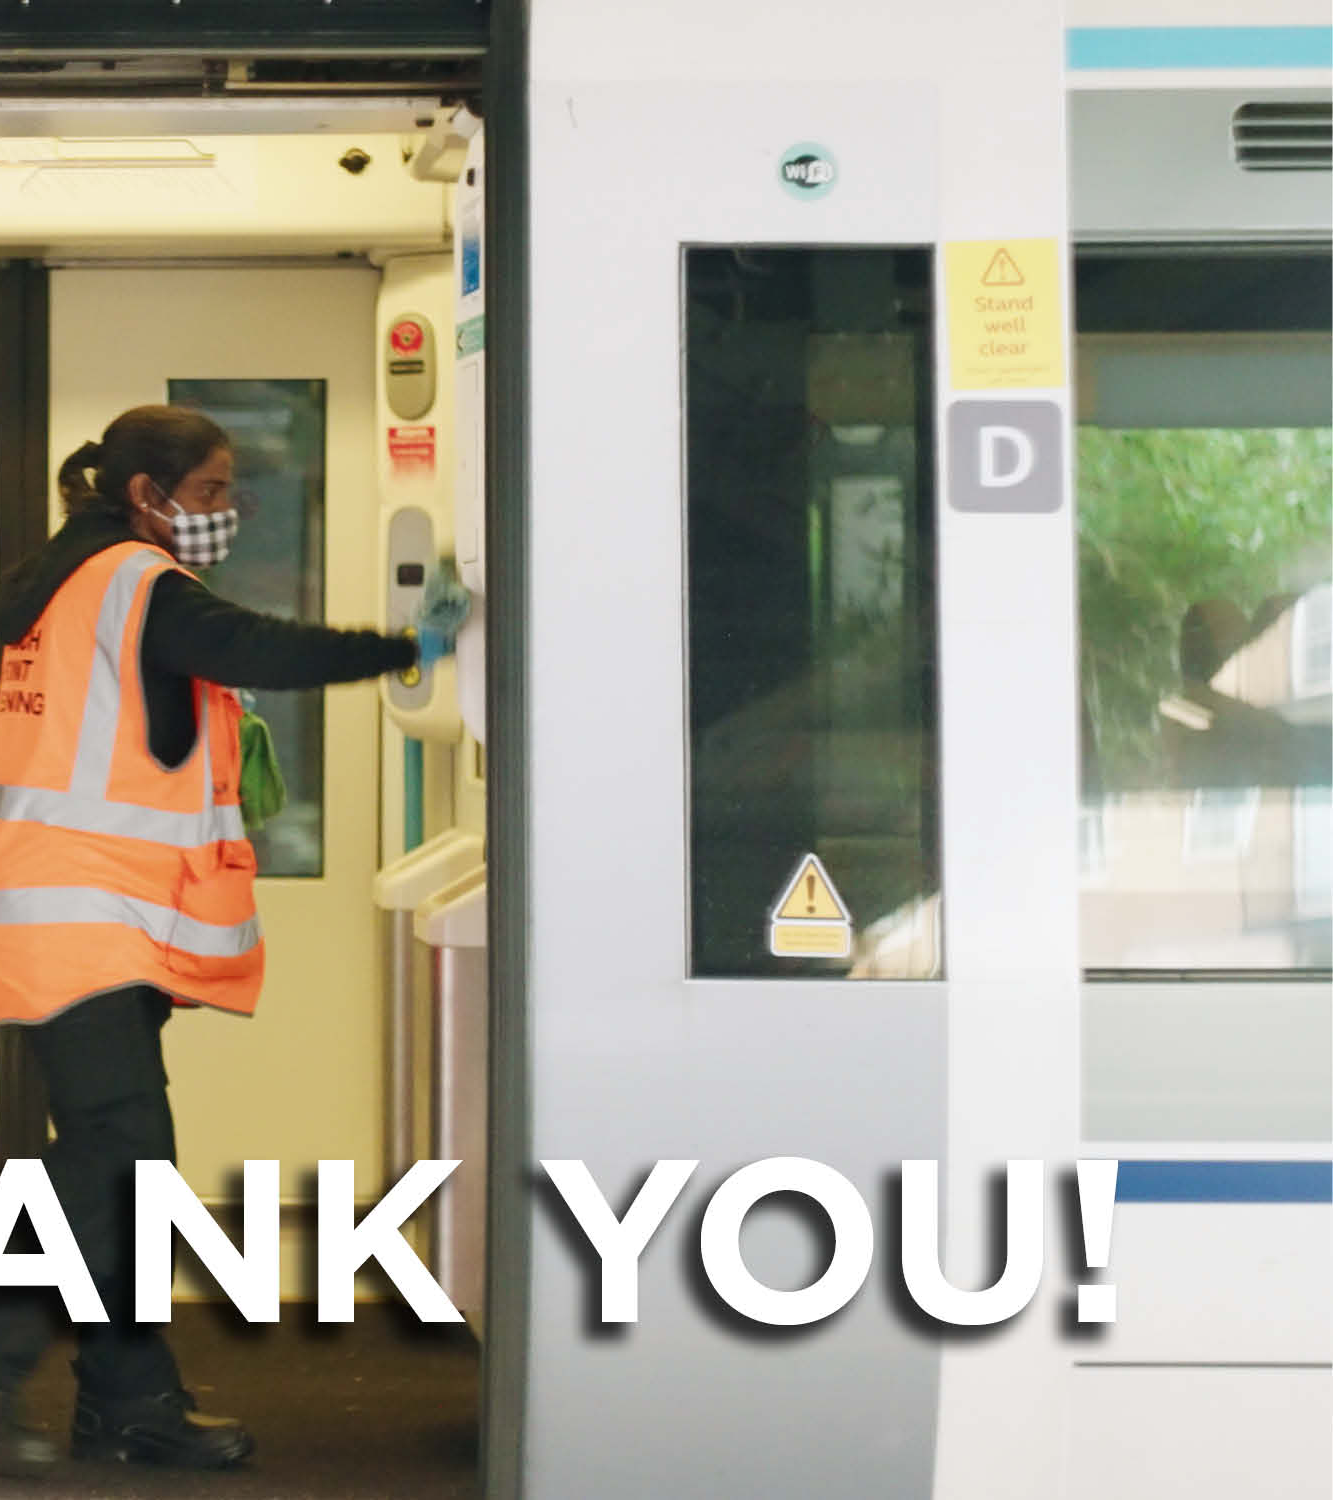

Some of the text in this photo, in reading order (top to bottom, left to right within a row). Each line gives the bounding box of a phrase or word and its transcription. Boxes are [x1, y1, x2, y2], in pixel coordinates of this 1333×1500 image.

[974, 295, 1034, 312] Stand
[984, 316, 1026, 334] well
[978, 339, 1029, 357] clear
[980, 426, 1034, 487] D
